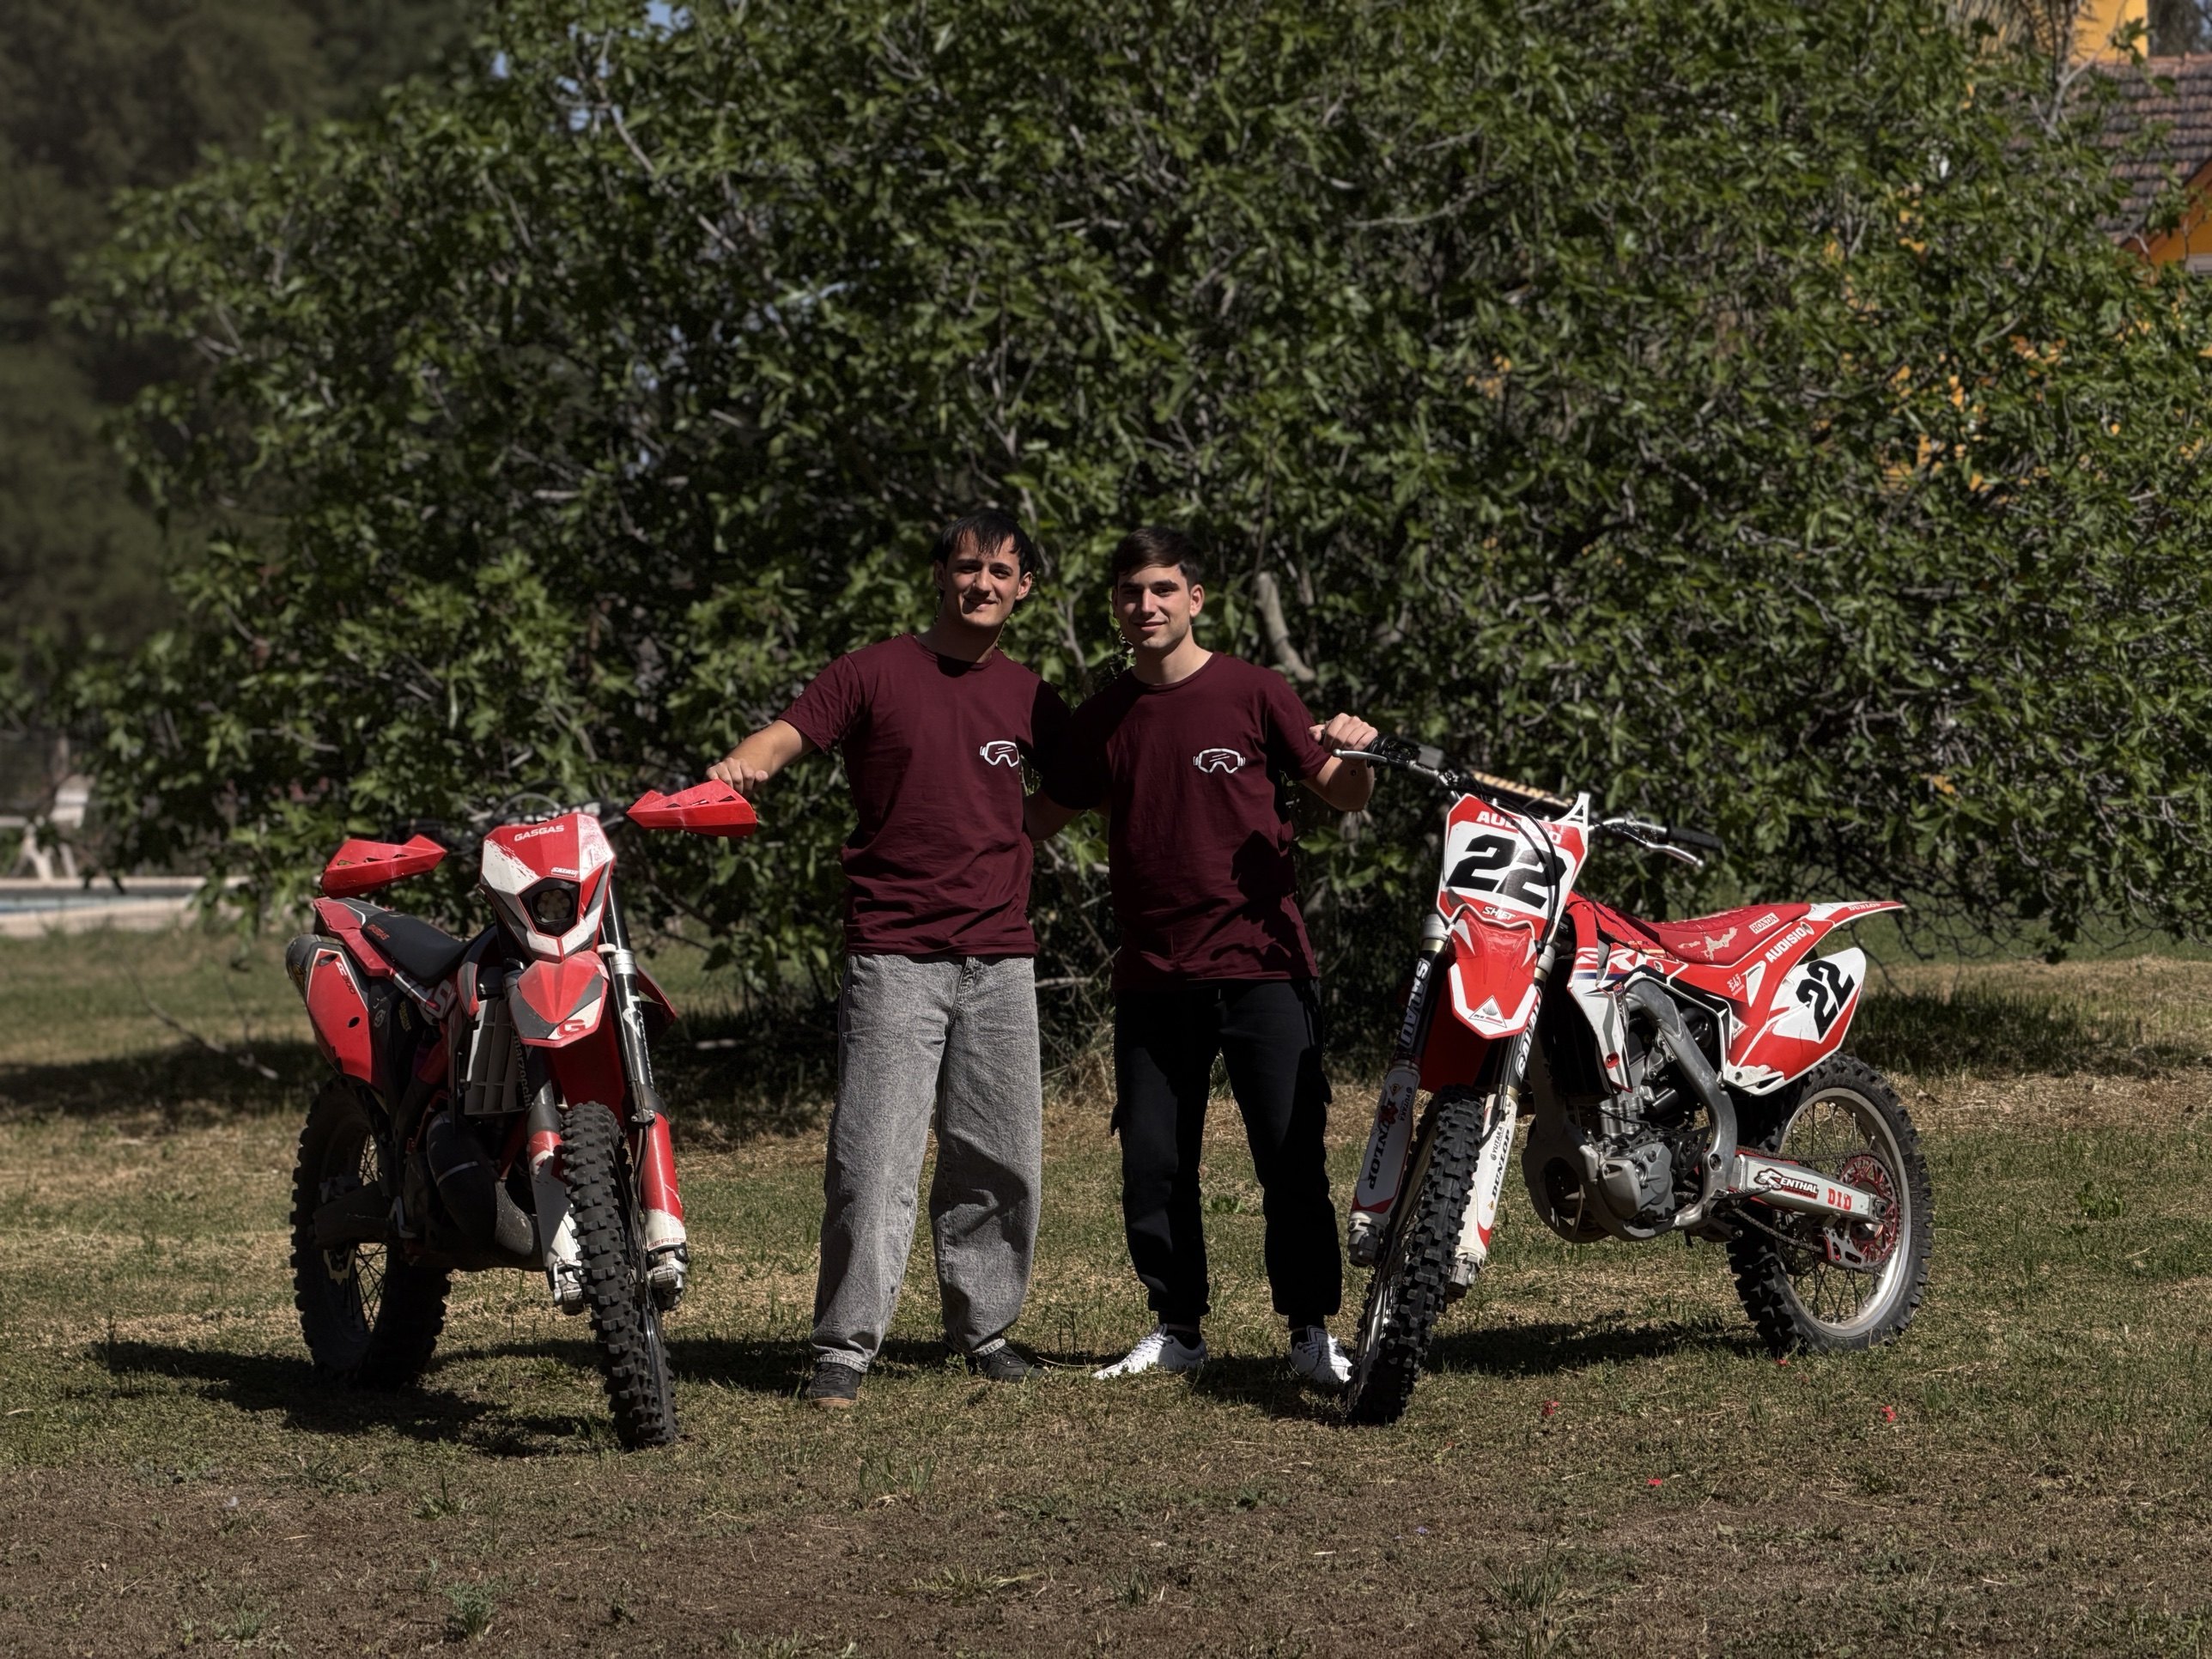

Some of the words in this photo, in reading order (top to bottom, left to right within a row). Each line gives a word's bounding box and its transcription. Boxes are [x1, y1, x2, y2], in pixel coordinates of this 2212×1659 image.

[514, 825, 564, 842] GASGAS
[1446, 834, 1568, 910] 22
[1751, 915, 1778, 933] HONDA
[1765, 927, 1807, 963] AUDISIO
[1399, 958, 1431, 1048] SALAU
[1796, 959, 1855, 1042] 22
[1400, 1094, 1413, 1121] YUTAKA
[1492, 1127, 1504, 1153] YUTAKA
[1492, 1128, 1510, 1197] DUNLOP
